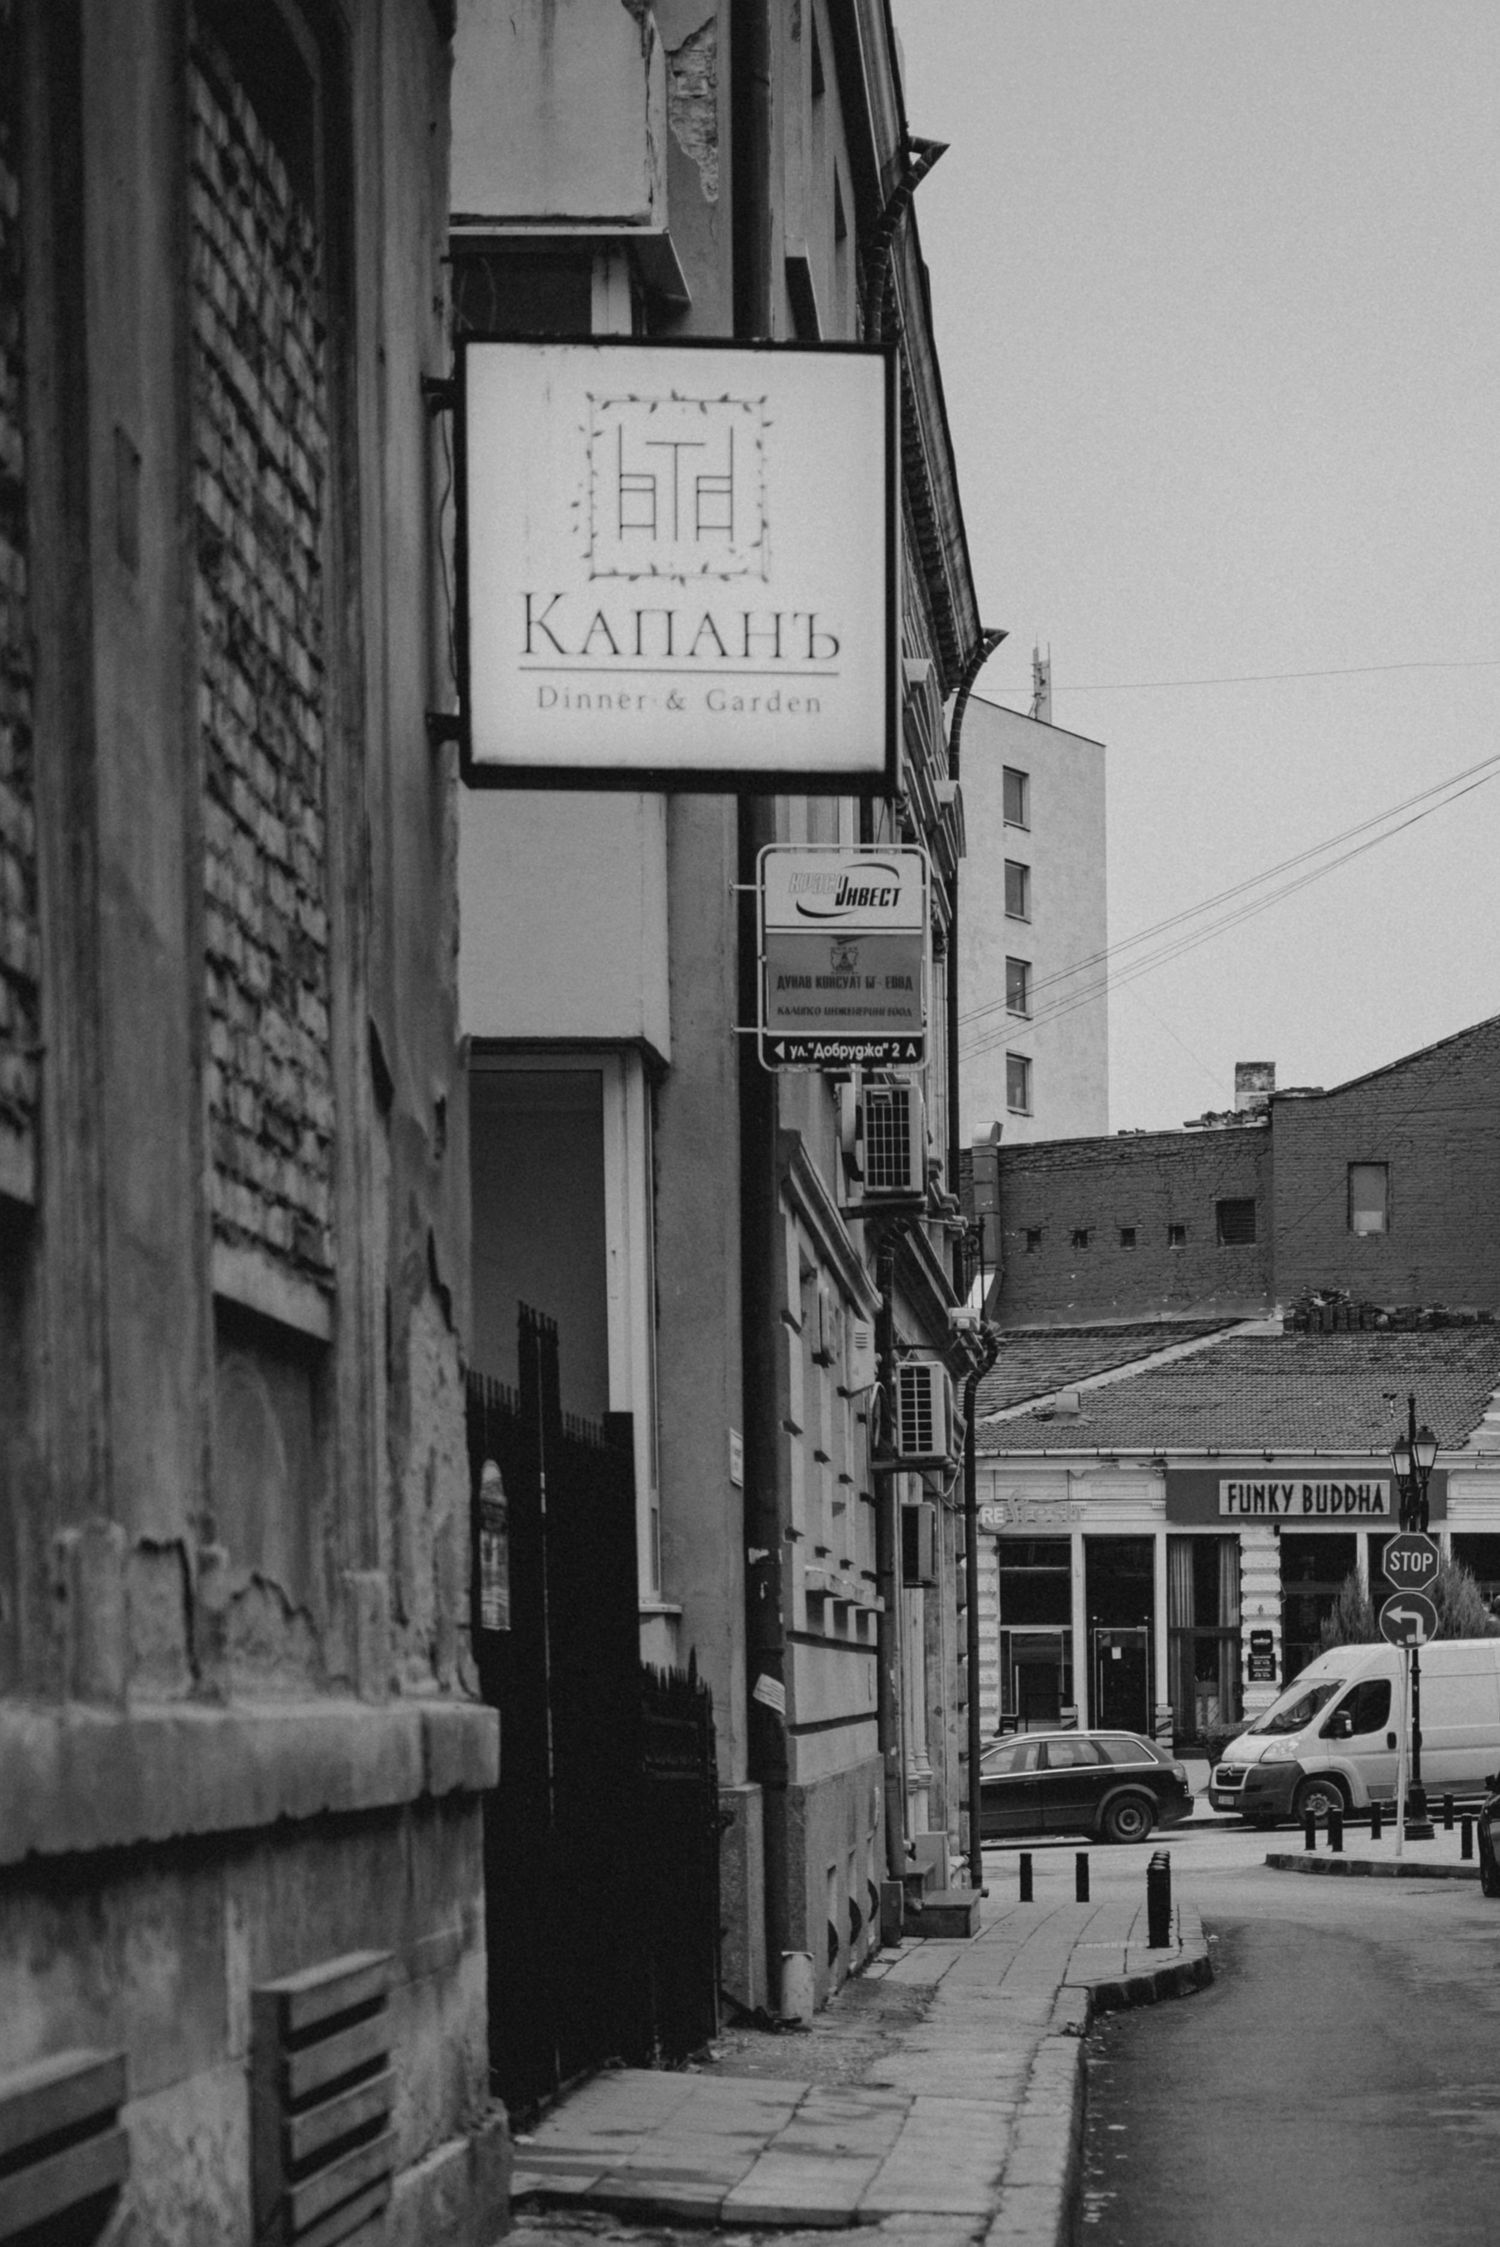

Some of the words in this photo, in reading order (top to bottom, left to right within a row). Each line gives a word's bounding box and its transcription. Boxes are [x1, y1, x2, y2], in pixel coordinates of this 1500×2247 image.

[537, 686, 649, 710] Dinner
[666, 689, 687, 710] &
[706, 688, 823, 714] Garden
[789, 1045, 808, 1060] ул.
[891, 1043, 900, 1057] 2
[1227, 1484, 1294, 1513] FUNKY
[1302, 1483, 1384, 1513] BUDDHA
[1389, 1551, 1433, 1572] STOP
